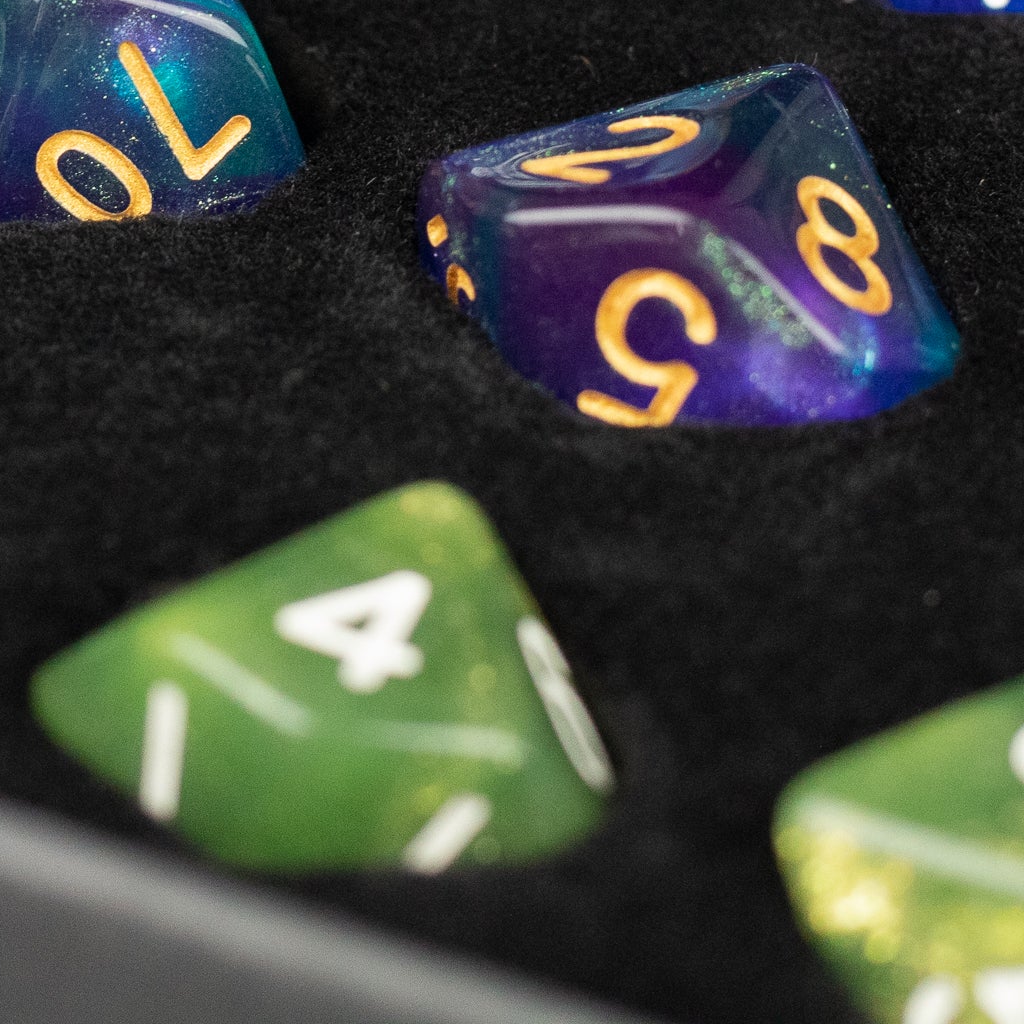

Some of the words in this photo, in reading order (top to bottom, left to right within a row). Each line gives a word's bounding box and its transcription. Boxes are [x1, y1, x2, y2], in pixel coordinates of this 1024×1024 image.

[35, 39, 253, 223] 70
[519, 114, 702, 185] 2
[795, 175, 894, 317] 8
[575, 266, 718, 429] 5
[274, 569, 433, 695] 4
